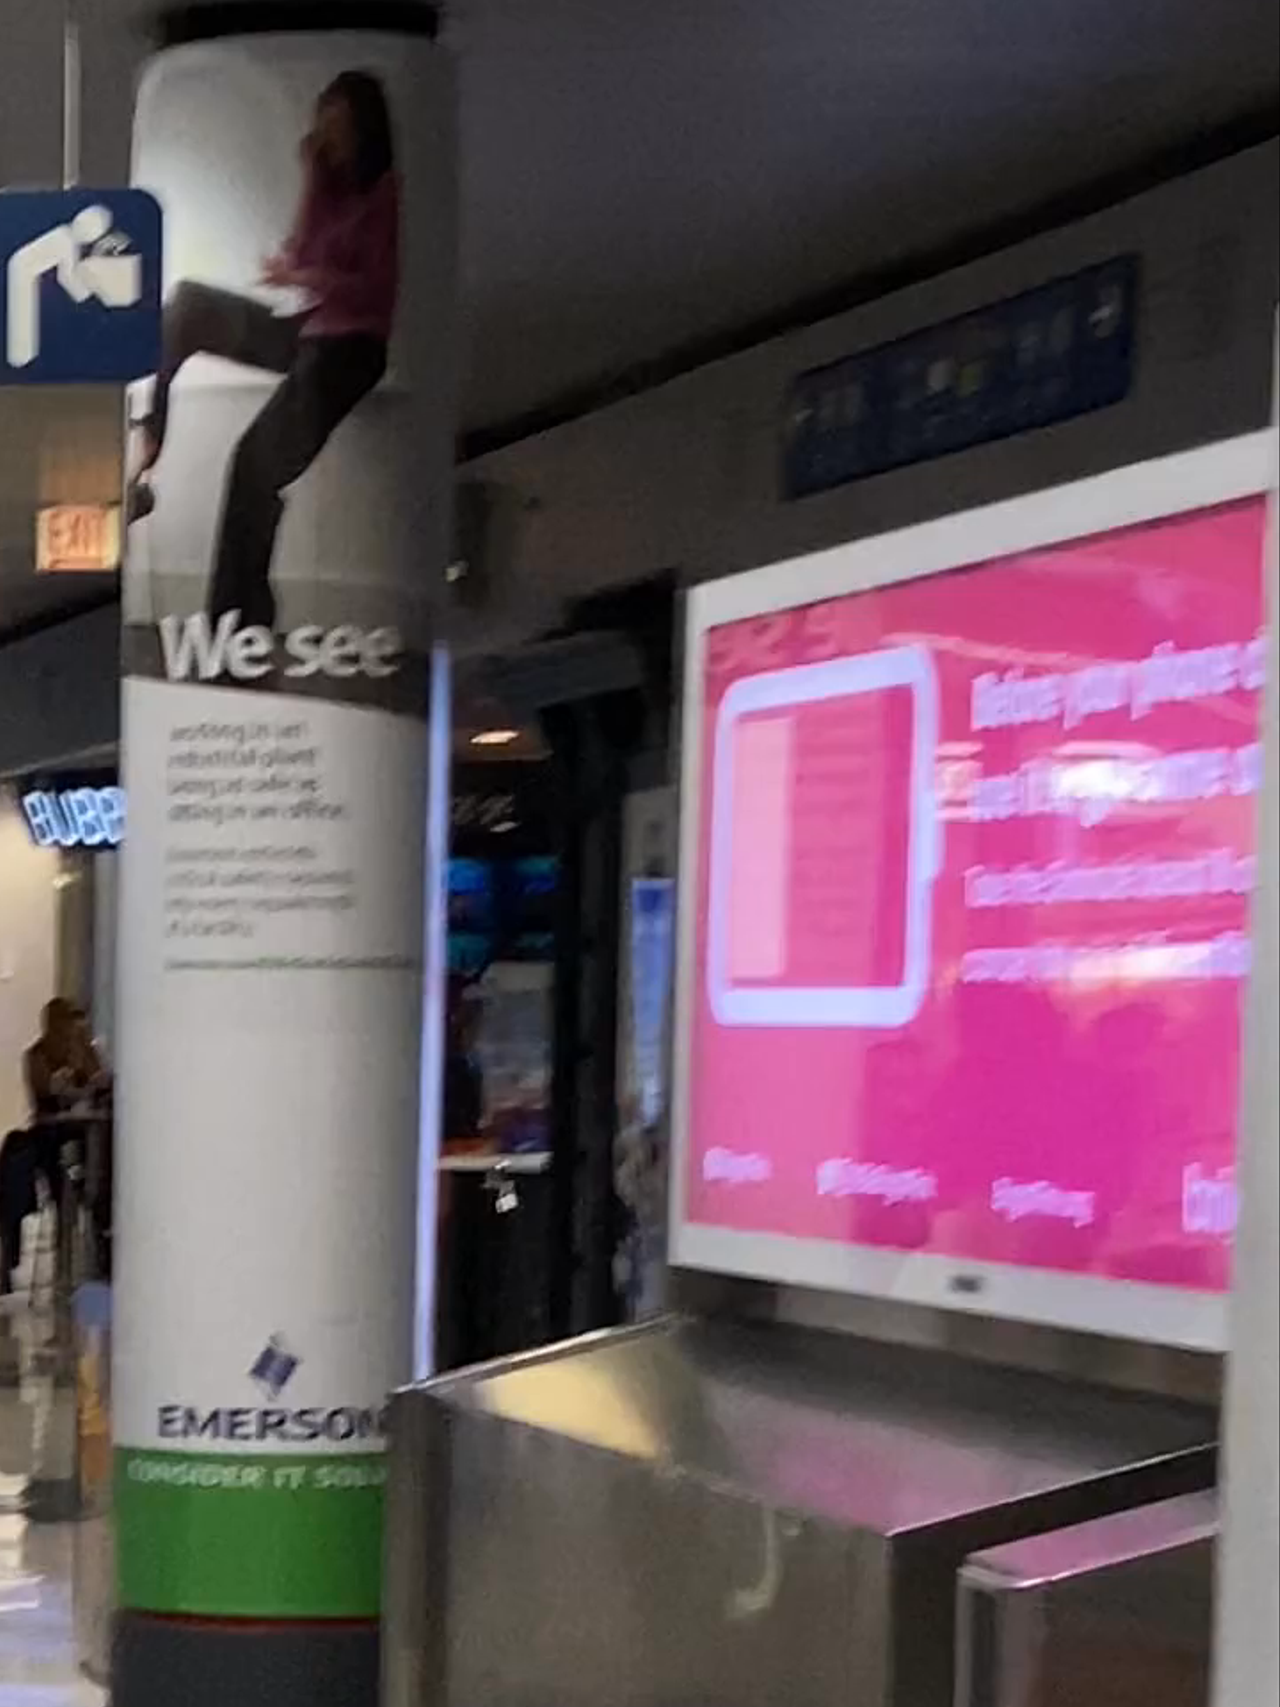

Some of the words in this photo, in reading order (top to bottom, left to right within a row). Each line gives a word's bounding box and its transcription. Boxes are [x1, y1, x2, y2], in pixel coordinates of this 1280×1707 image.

[158, 608, 276, 681] We
[284, 623, 402, 679] see
[157, 1404, 390, 1442] EMERSON
